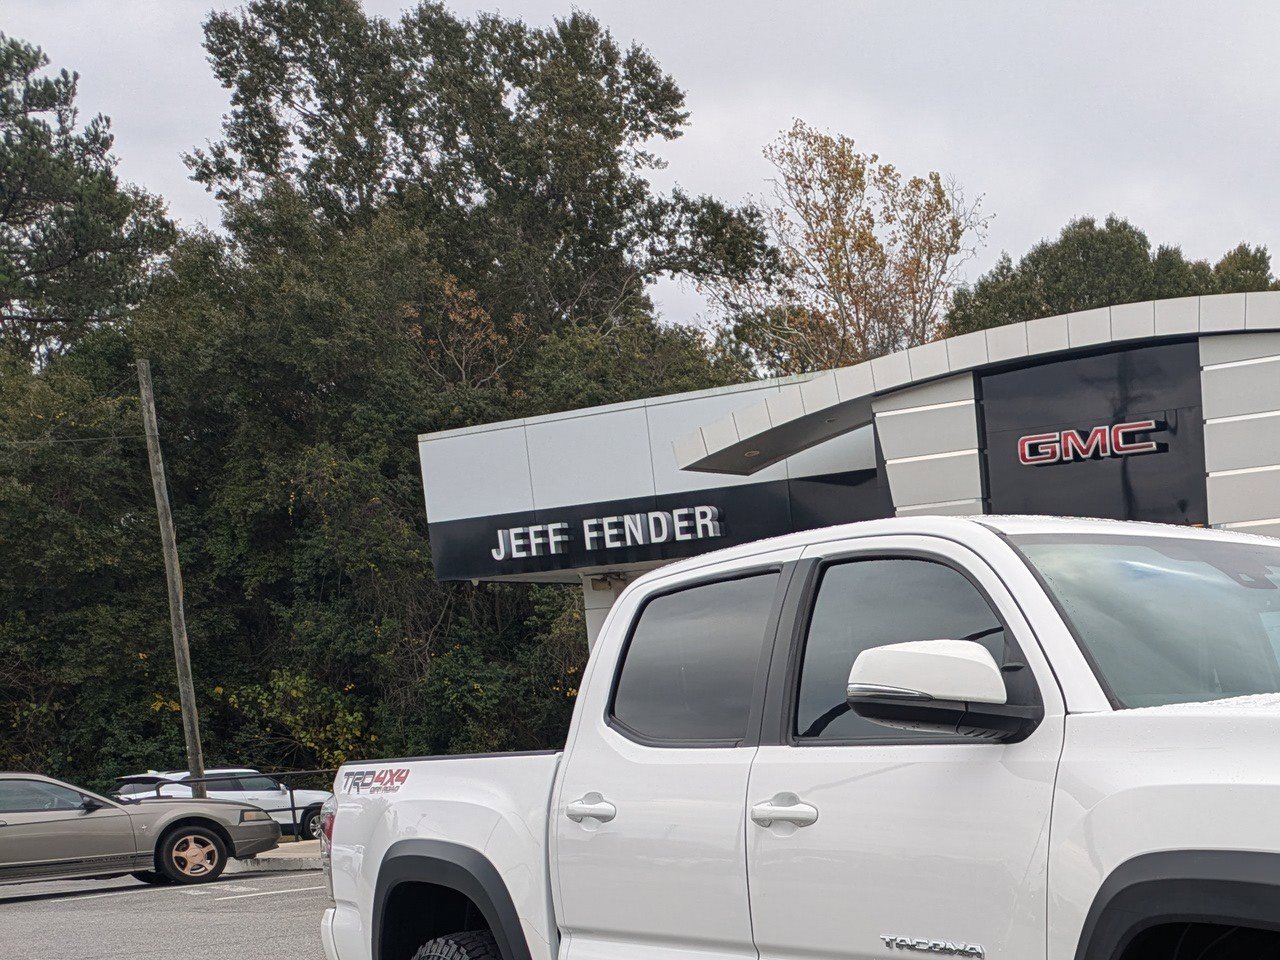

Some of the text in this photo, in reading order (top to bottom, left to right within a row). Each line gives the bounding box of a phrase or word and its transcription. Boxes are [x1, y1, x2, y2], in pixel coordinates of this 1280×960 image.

[1018, 419, 1157, 465] GMC
[491, 505, 721, 561] JEFF FENDER
[880, 934, 985, 960] TACOMA
